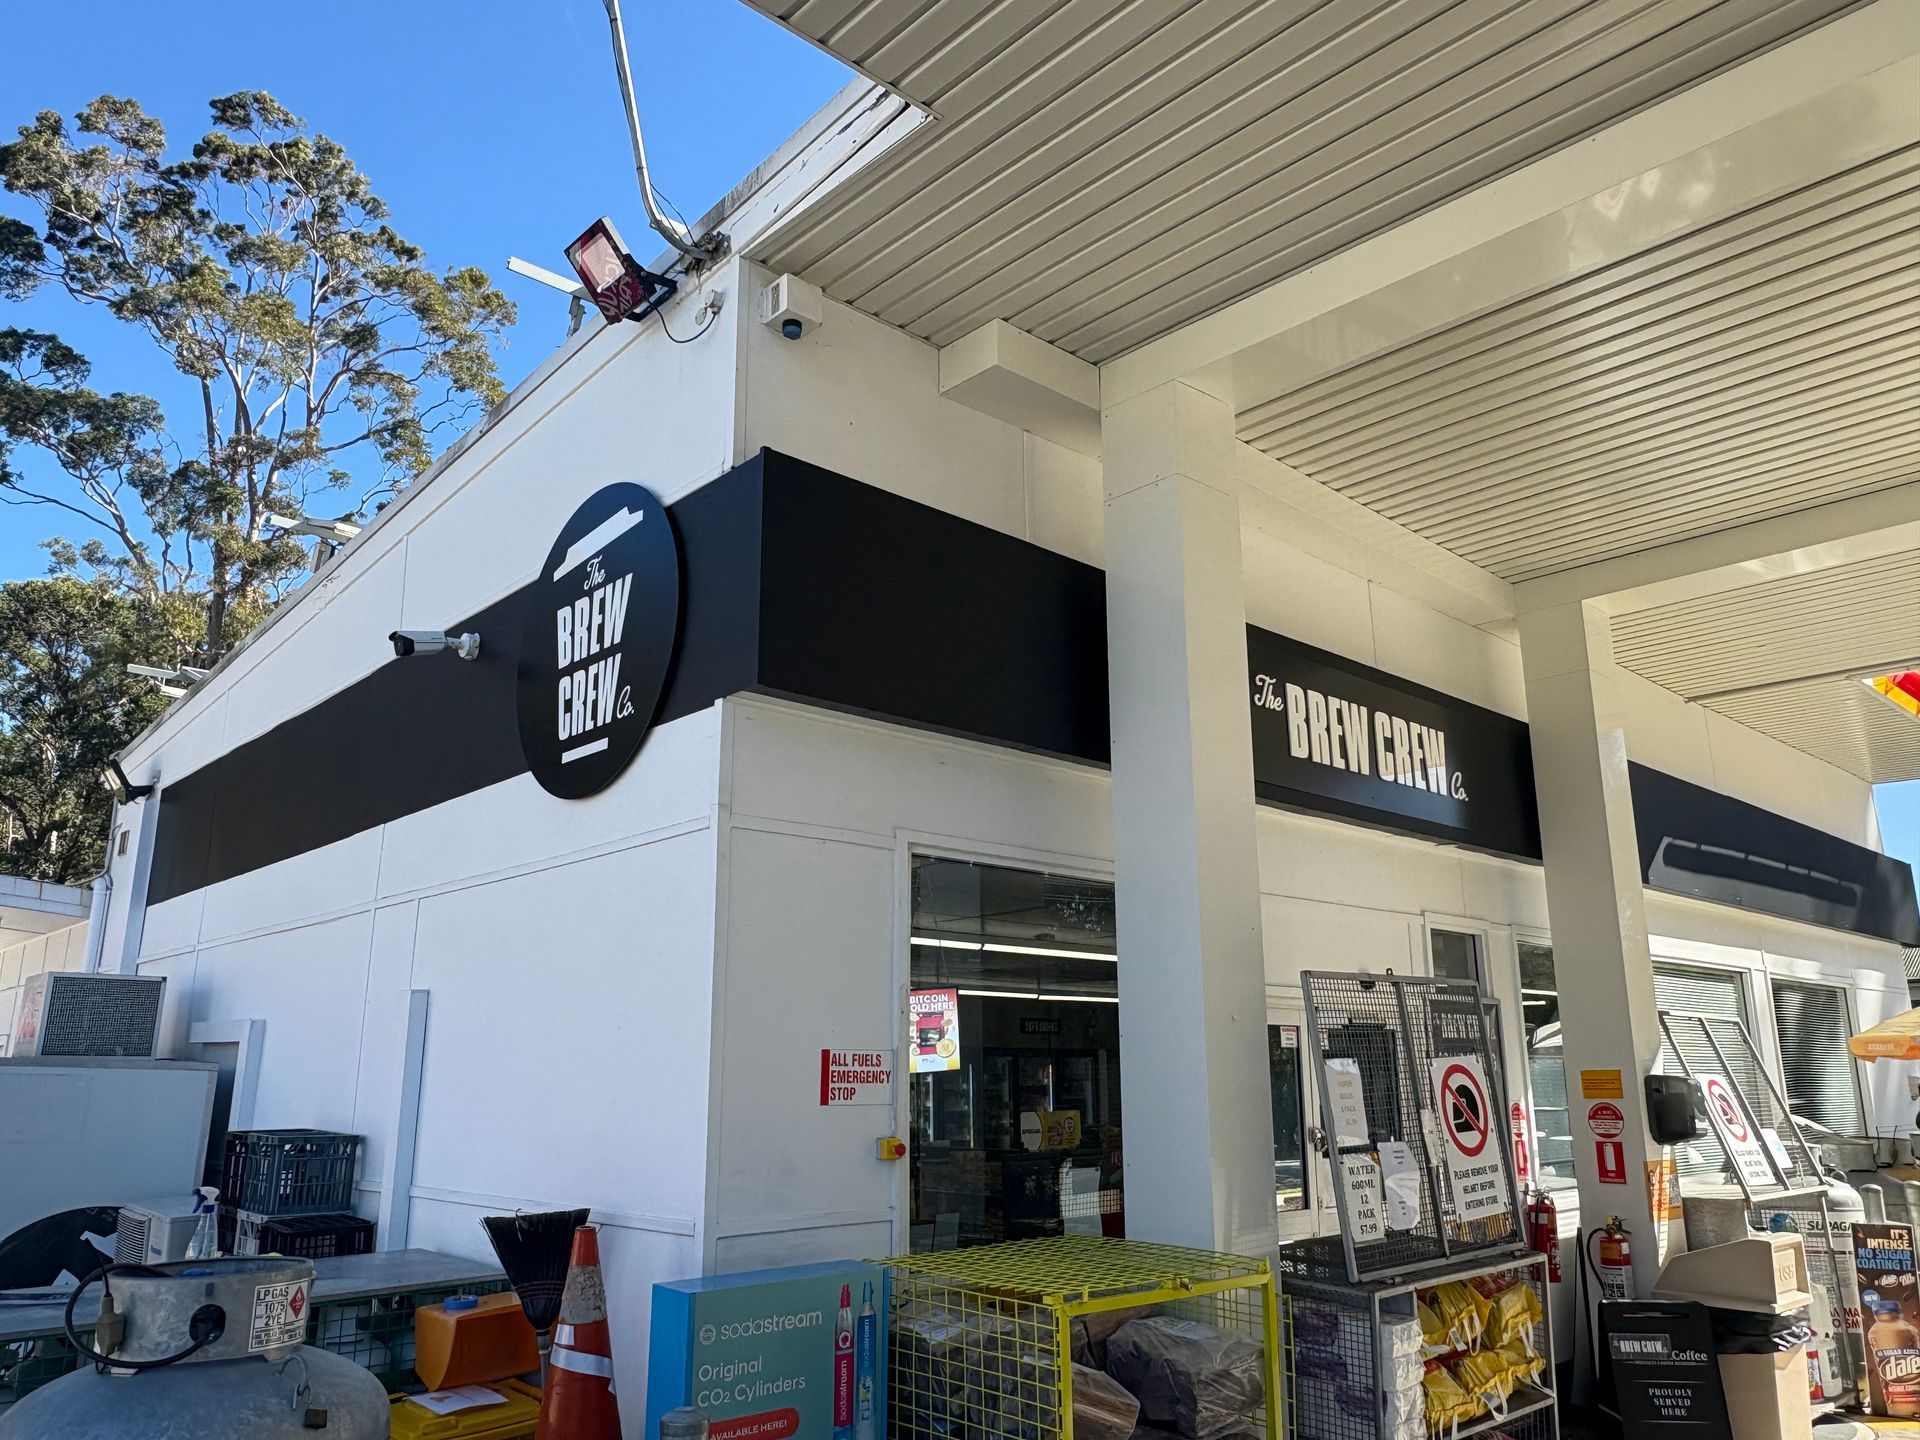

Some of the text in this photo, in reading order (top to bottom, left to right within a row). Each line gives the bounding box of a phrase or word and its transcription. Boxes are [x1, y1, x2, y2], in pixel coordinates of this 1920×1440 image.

[583, 554, 606, 591] The
[557, 572, 633, 671] BREW
[558, 652, 636, 742] CREW Co.
[1254, 674, 1469, 801] The BREW CREW Co.
[910, 993, 949, 1004] BITCOIN
[910, 1001, 955, 1013] OLD HERE
[830, 1052, 882, 1068] ALL FUELS
[830, 1069, 892, 1085] EMERGENCY
[829, 1086, 857, 1102] STOP
[1348, 1164, 1376, 1177] WATER
[1453, 1168, 1471, 1180] PLEASE
[1351, 1178, 1376, 1190] 600ML
[1360, 1193, 1369, 1205] 12
[1357, 1207, 1376, 1220] PACK
[1889, 1228, 1910, 1240] IT'S
[1857, 1247, 1912, 1261] NO SUGAR
[1856, 1258, 1901, 1270] COATING
[257, 1286, 290, 1301] LP GAS
[264, 1302, 286, 1315] 1075
[264, 1312, 283, 1327] 2YE
[720, 1309, 823, 1341] sodastream
[1619, 1340, 1642, 1353] BREW
[1641, 1340, 1663, 1353] CREW
[1671, 1350, 1708, 1361] Coffee
[698, 1355, 763, 1383] Original
[1885, 1355, 1920, 1381] dare
[734, 1375, 806, 1403] Cylinders
[1648, 1387, 1693, 1397] PROUDLY
[1653, 1397, 1692, 1407] SERVED
[1661, 1407, 1688, 1417] HERE
[710, 1419, 788, 1440] AVAILABLE HERE!
